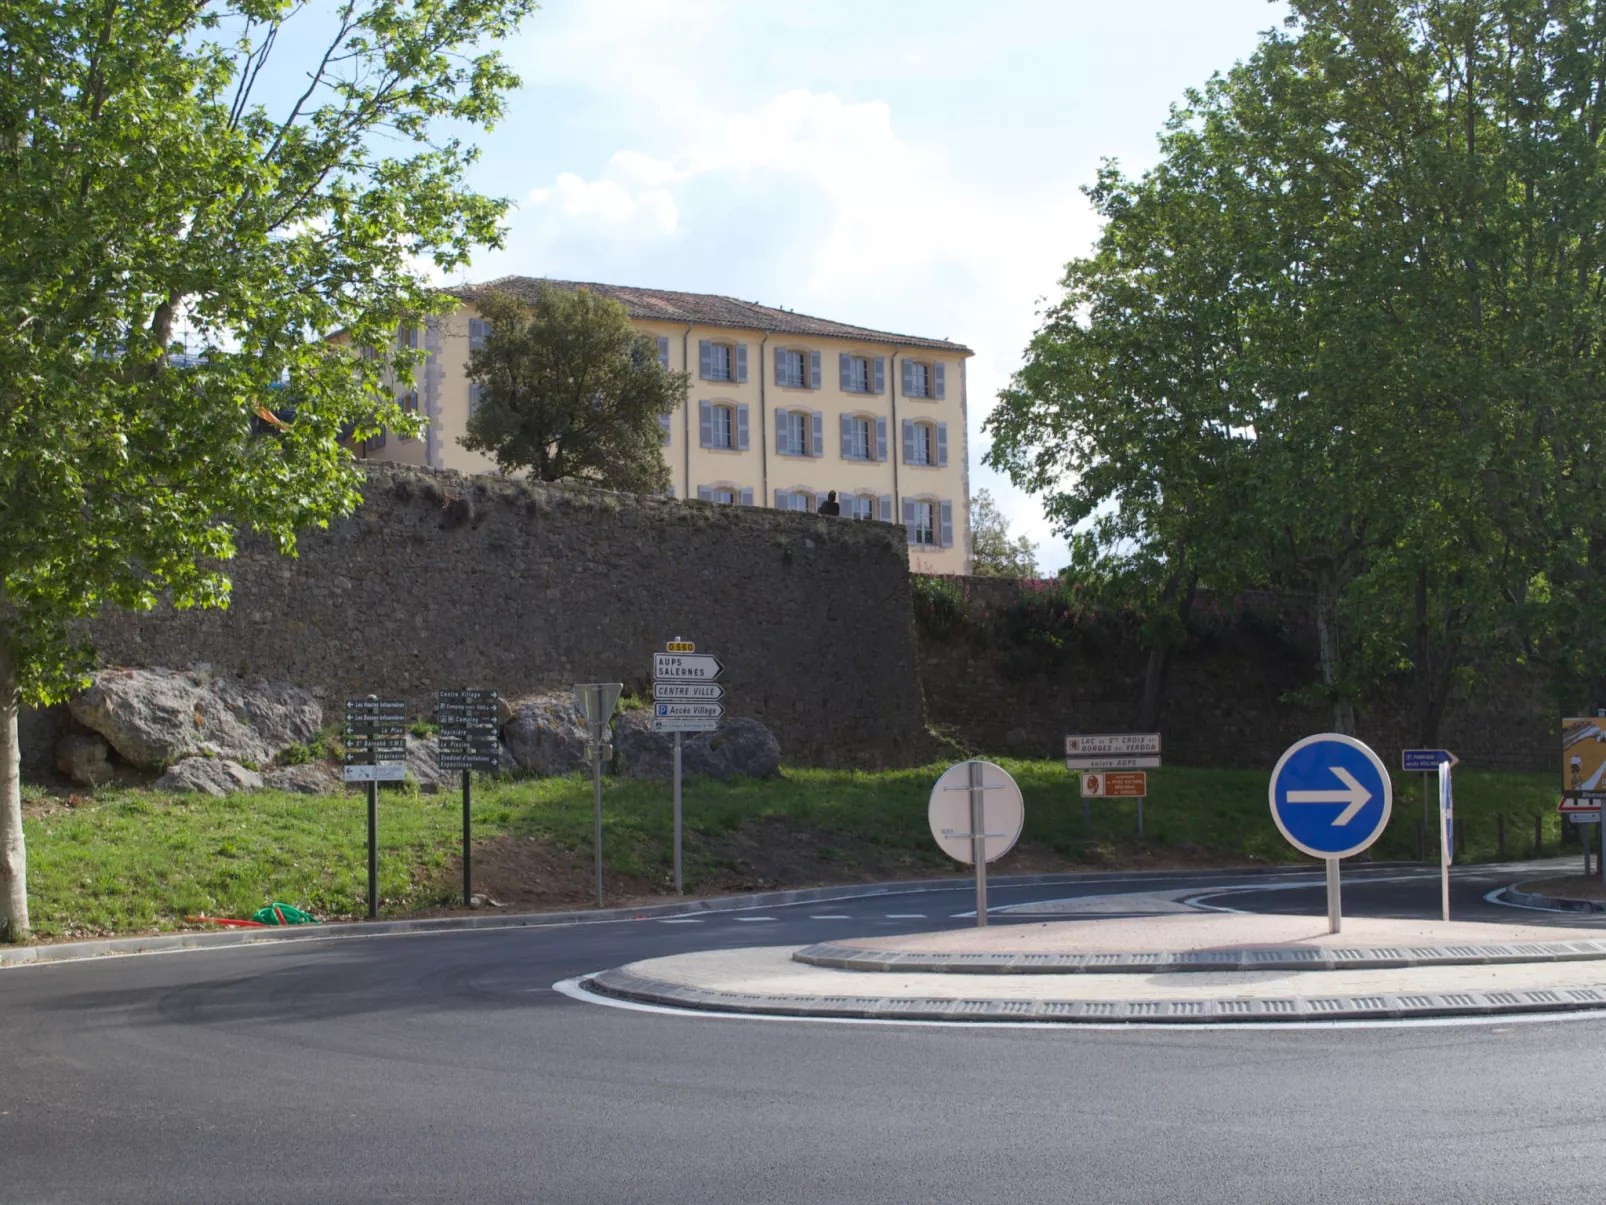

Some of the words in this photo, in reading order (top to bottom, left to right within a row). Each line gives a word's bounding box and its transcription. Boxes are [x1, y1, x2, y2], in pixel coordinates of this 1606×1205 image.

[669, 643, 674, 651] D
[658, 658, 682, 666] AUPS
[658, 667, 705, 676] SALERNES
[461, 691, 481, 699] Village
[658, 687, 689, 696] CENTRE
[693, 687, 715, 696] VILLE
[669, 705, 691, 714] Accès
[693, 705, 716, 716] Village
[455, 716, 479, 725] Camping
[1125, 743, 1156, 751] VERDON
